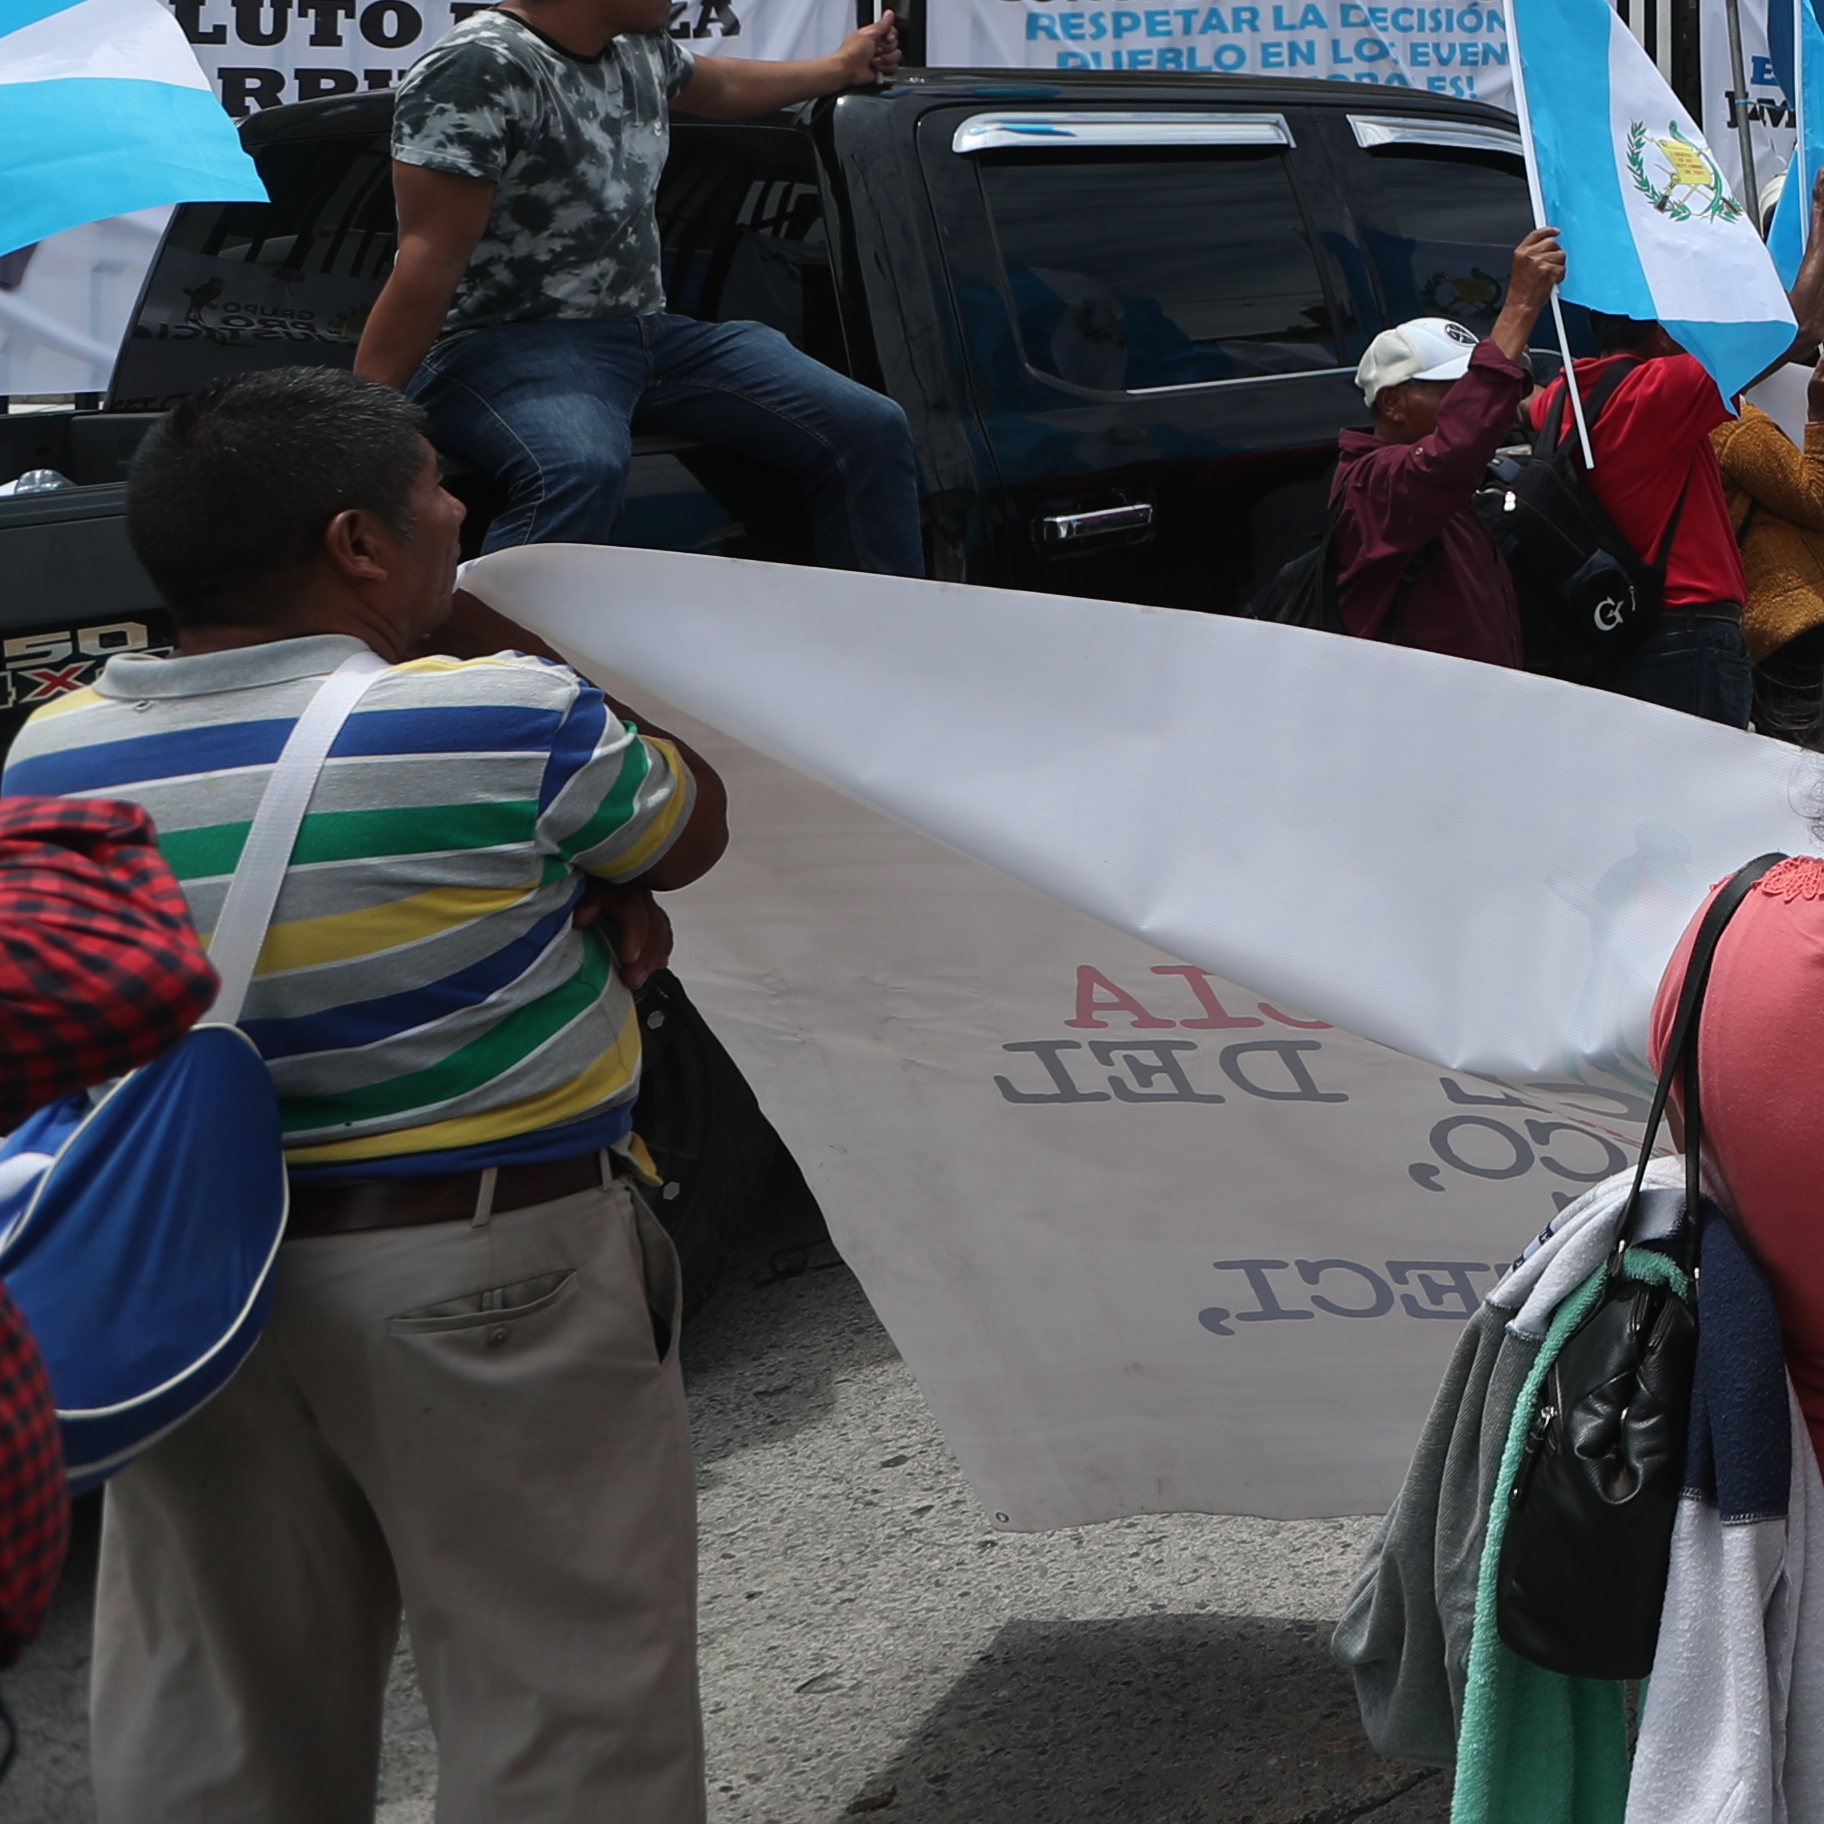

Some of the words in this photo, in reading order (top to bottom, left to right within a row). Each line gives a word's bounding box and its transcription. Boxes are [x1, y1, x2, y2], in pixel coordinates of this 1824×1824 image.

[1026, 5, 1261, 42] RESPETAR
[1272, 2, 1328, 31] LA
[1260, 39, 1315, 69] EN
[1409, 41, 1508, 67] EVEN
